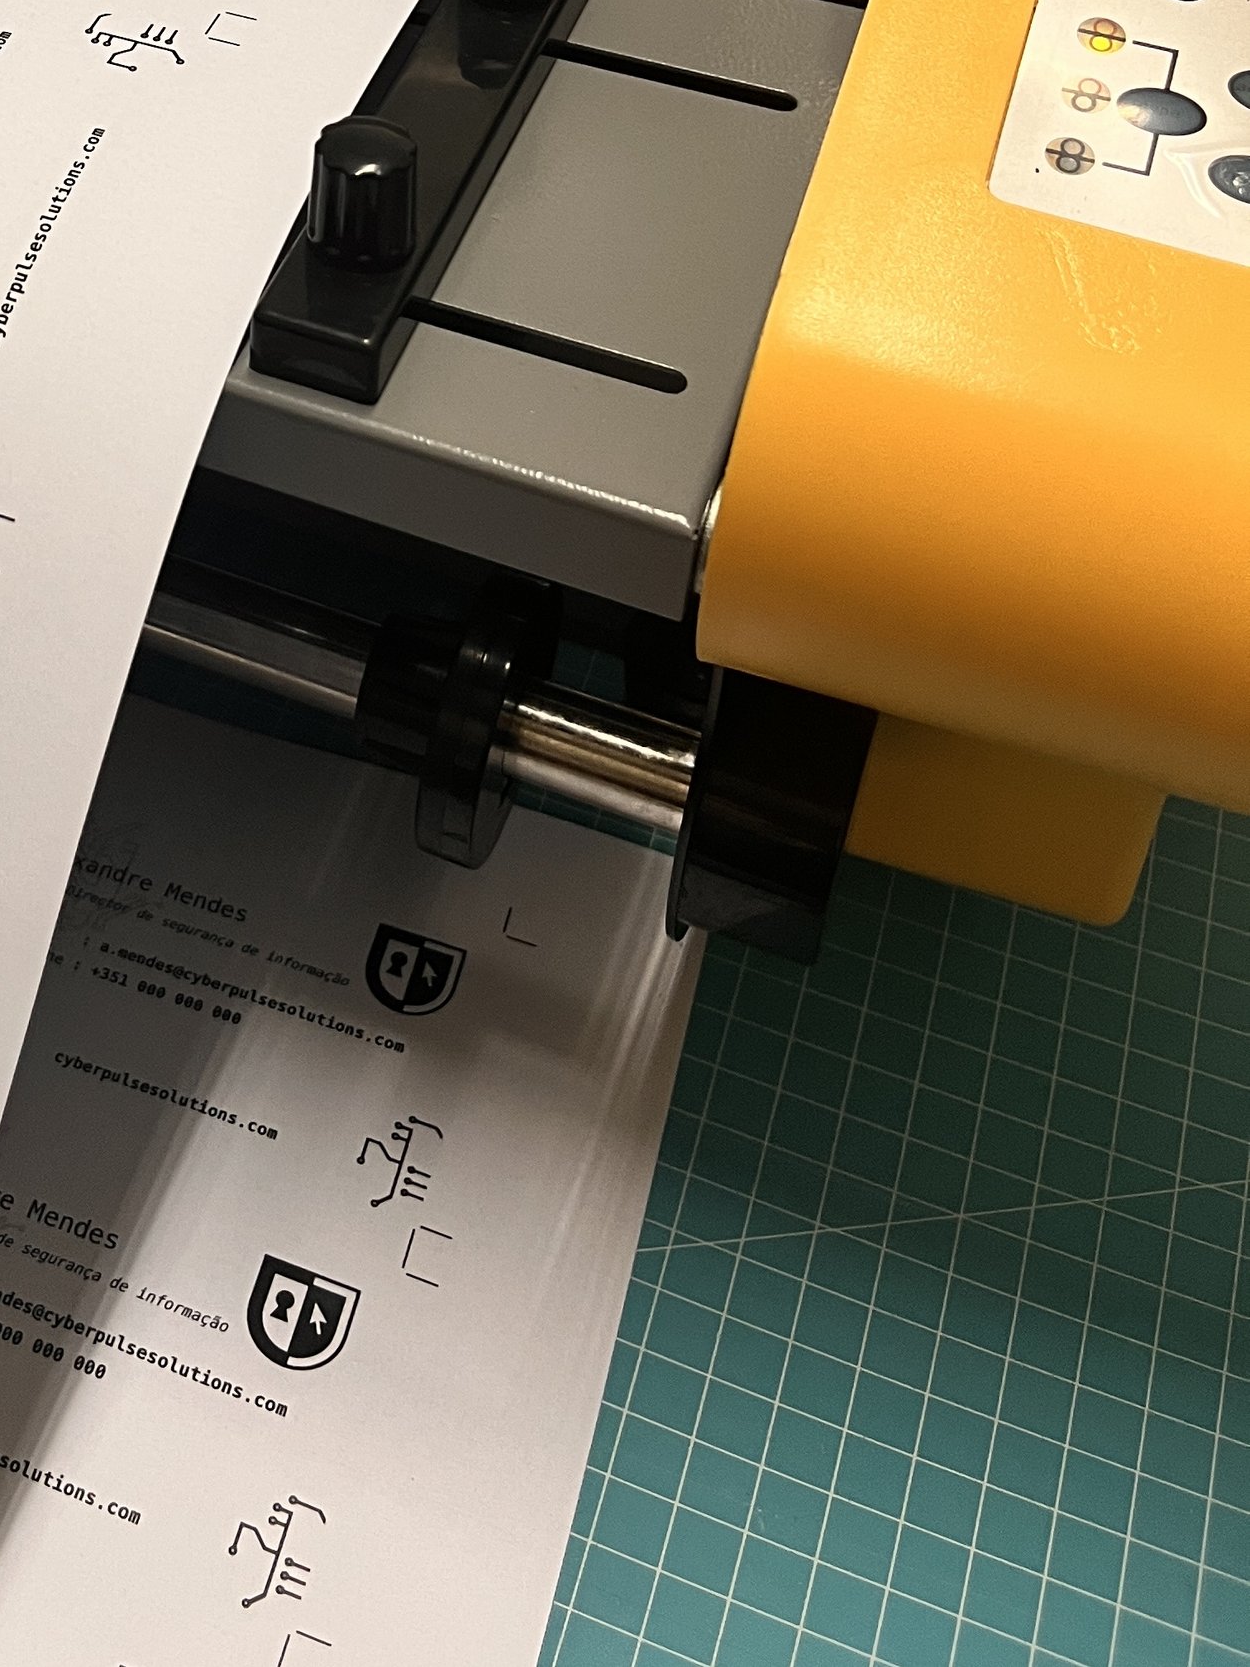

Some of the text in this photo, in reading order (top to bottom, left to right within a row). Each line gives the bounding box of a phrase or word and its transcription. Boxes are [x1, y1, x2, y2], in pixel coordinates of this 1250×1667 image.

[26, 1198, 119, 1250] Mendes
[20, 1244, 103, 1283] segurança
[108, 1276, 129, 1293] de
[135, 1286, 230, 1333] informação
[31, 1338, 65, 1363] 000
[73, 1354, 107, 1380] 000
